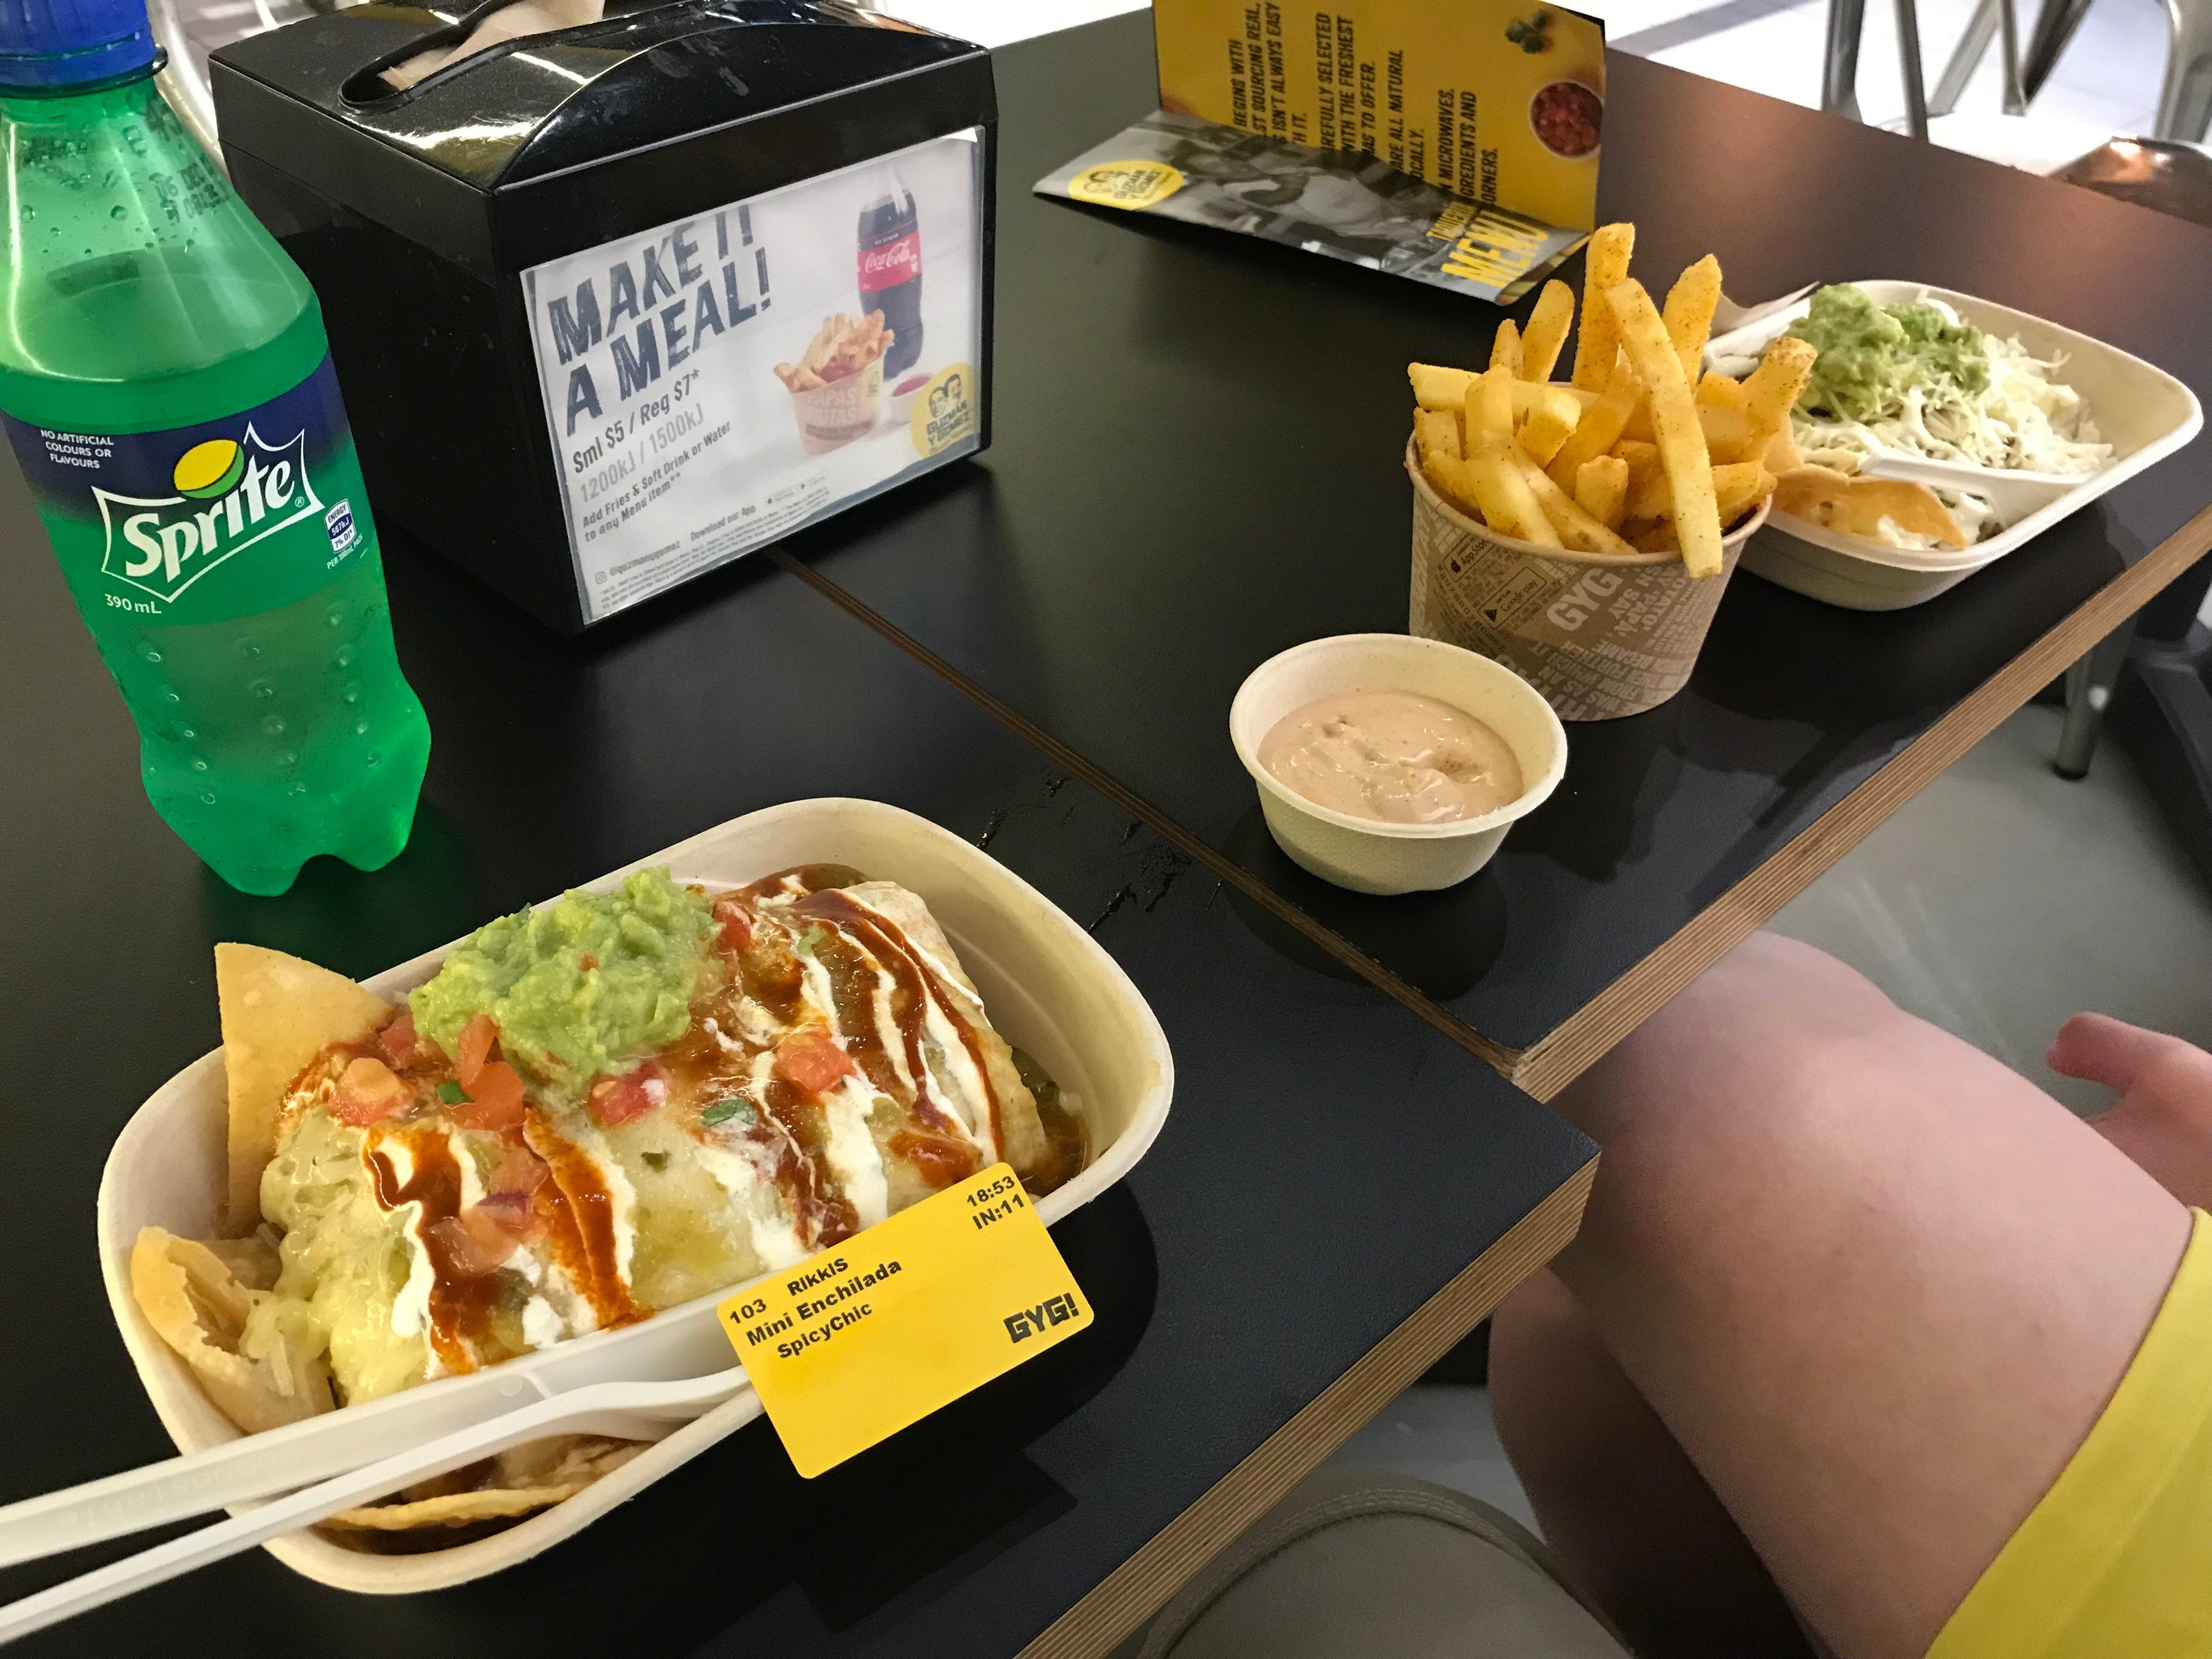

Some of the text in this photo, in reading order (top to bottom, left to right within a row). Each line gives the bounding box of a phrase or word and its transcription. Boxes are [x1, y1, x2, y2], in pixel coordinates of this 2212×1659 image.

[1265, 1, 1282, 36] EASY
[1266, 40, 1285, 93] ALWAYS
[1336, 15, 1354, 87] FRESHEST
[1228, 38, 1248, 127] BEGINS WITH
[1247, 44, 1265, 113] SOURCING
[1316, 12, 1335, 149] REFULLY SELECTED
[1339, 90, 1355, 116] THE
[1387, 48, 1403, 113] NATURAL
[1361, 112, 1375, 129] TO
[1388, 118, 1403, 142] ALL
[1459, 91, 1477, 198] GREDIENTS AND
[1409, 128, 1425, 178] OCALLY.
[1481, 148, 1498, 203] ORNERS.
[1440, 211, 1548, 288] MENU
[548, 222, 703, 366] MAKE
[567, 247, 771, 437] A MEAL!
[41, 430, 114, 445] NO ARTIFICIAL
[45, 441, 112, 457] COLOURS OR
[573, 436, 603, 473] Sml
[605, 420, 625, 449] $5
[640, 394, 670, 426] Reg
[580, 450, 636, 503] 1200kJ
[650, 403, 704, 454] 1500kJ
[50, 453, 100, 469] FLAVOURS
[583, 421, 731, 528] Add Fries & Soft Drink or Water
[123, 454, 295, 583] Sprite
[328, 504, 346, 523] ENERGY
[585, 530, 596, 542] to
[599, 517, 619, 535] any
[620, 498, 647, 522] Menu
[1461, 551, 1475, 566] App
[105, 594, 161, 614] 390 mL
[1546, 568, 1623, 631] GYG
[966, 1176, 1016, 1207] 18:53
[972, 1194, 1025, 1230] IN:11
[729, 1298, 768, 1325] 103
[746, 1258, 902, 1346] Mini Enchilada
[1003, 1292, 1080, 1344] GYG!
